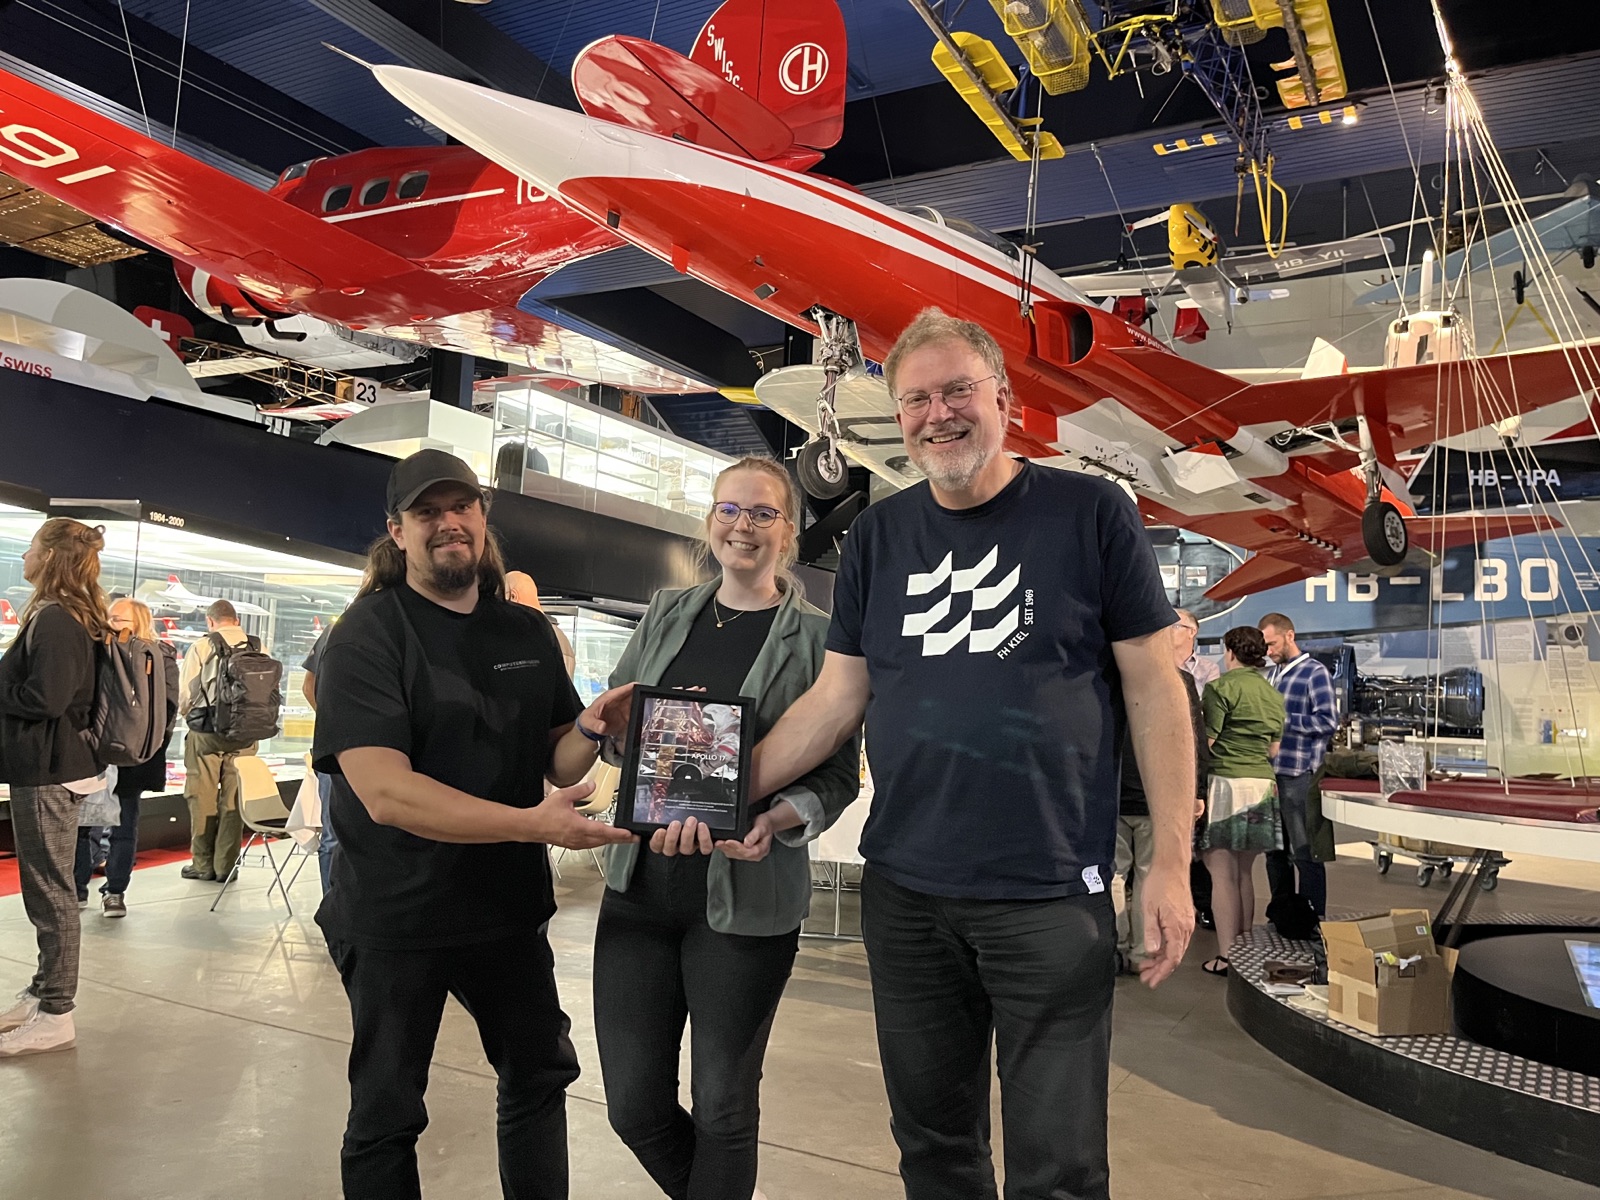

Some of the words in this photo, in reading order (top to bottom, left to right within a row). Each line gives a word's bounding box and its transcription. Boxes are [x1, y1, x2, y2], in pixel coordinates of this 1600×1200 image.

[782, 46, 823, 91] CH
[1274, 249, 1352, 270] HB-YIL
[4, 356, 52, 378] SWISS
[356, 382, 376, 403] 23
[1470, 469, 1561, 487] HB-HPA
[150, 511, 185, 527] 1964-2000
[1305, 558, 1559, 602] HB-LBO
[1024, 589, 1034, 606] 1969
[1024, 608, 1034, 626] SEIT
[1007, 631, 1030, 649] KIEL
[997, 646, 1011, 660] FH
[691, 753, 717, 761] APOLLO
